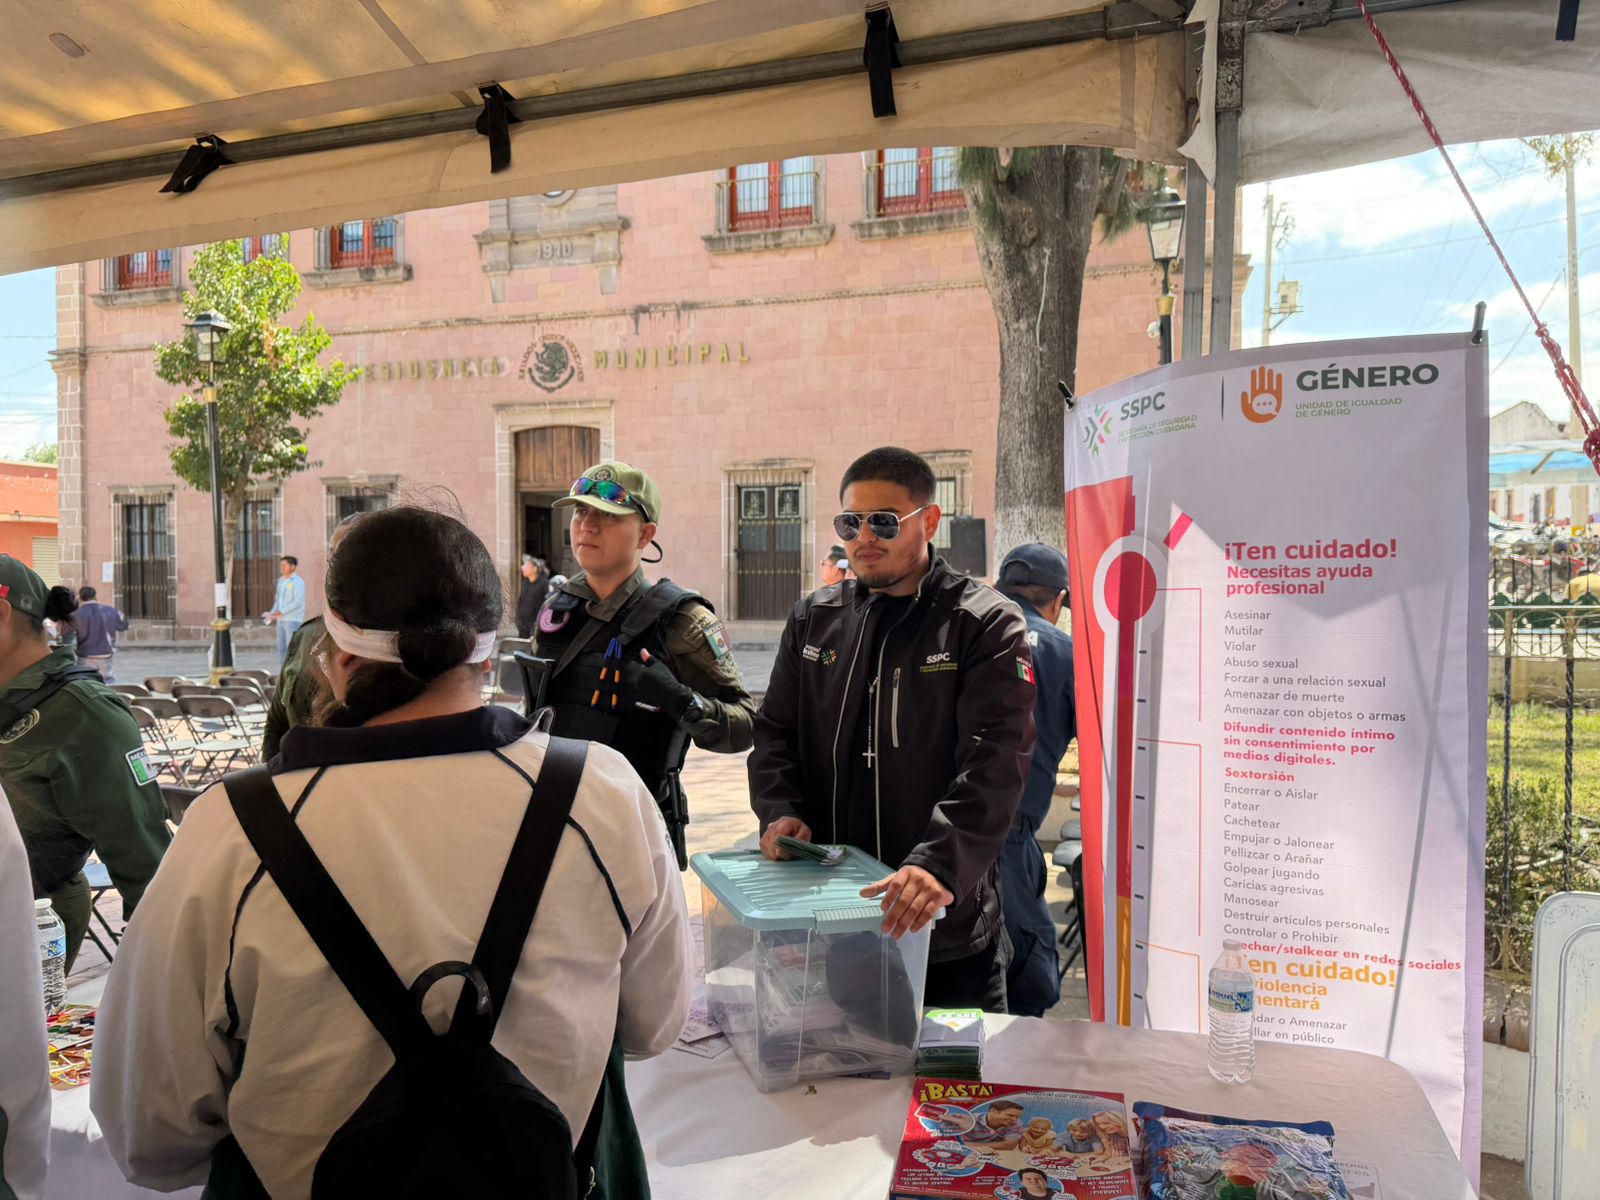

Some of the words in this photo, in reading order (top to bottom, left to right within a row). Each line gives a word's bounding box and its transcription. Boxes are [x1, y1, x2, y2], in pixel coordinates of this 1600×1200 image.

[593, 341, 751, 370] MUNICIPAL
[1296, 363, 1440, 392] GÉNERO
[1120, 391, 1166, 421] SSPC
[1295, 401, 1333, 410] UNIDAD
[1335, 400, 1349, 408] DE
[1351, 397, 1402, 407] IGUALDAD
[1295, 410, 1309, 418] DE
[1310, 408, 1351, 418] GÉNERO
[1225, 542, 1277, 561] ¡Ten
[1284, 538, 1397, 560] cuidado!
[1227, 565, 1311, 579] Necesitas
[1316, 564, 1373, 581] ayuda
[1226, 580, 1325, 598] profesional
[1224, 609, 1271, 620] Asesinar
[1224, 625, 1264, 636] Mutilar
[1224, 641, 1256, 652] Violar
[926, 652, 950, 664] SSPC
[1224, 657, 1259, 668] Abuso
[1262, 658, 1299, 669] sexual
[1224, 672, 1260, 684] Forzar
[1262, 676, 1269, 685] a
[1272, 676, 1294, 686] una
[1297, 675, 1344, 687] relación
[1347, 677, 1386, 688] sexual
[1224, 688, 1279, 701] Amenazar
[1283, 690, 1298, 701] de
[1302, 692, 1345, 703] muerte
[1224, 704, 1279, 717] Amenazar
[1283, 709, 1304, 718] con
[1308, 707, 1353, 721] objetos
[1356, 711, 1364, 720] o
[1368, 711, 1406, 722] armas
[1223, 721, 1275, 735] Difundir
[1279, 725, 1346, 739] contenido
[1223, 735, 1241, 746] sin
[1244, 738, 1346, 753] consentimiento
[1350, 744, 1376, 756] por
[1223, 750, 1270, 762] medios
[1273, 752, 1336, 767] digitales.
[1224, 767, 1295, 783] Sextorsión
[1224, 783, 1271, 797] Encerrar
[1274, 789, 1282, 798] o
[1285, 788, 1319, 801] Aislar
[1224, 799, 1260, 812] Patear
[1223, 815, 1281, 830] Cachetear
[1224, 831, 1270, 846] Empujar
[1273, 837, 1281, 846] o
[1284, 836, 1335, 850] Jalonear
[1224, 846, 1270, 861] Pellizcar
[1273, 853, 1281, 862] o
[1284, 852, 1324, 865] Arañar
[1223, 862, 1269, 877] Golpear
[1272, 866, 1320, 881] jugando
[1223, 877, 1267, 892] Caricias
[1270, 883, 1325, 897] agresivas
[1223, 893, 1279, 908] Manosear
[1223, 908, 1269, 923] Destruir
[1272, 913, 1322, 928] artículos
[1325, 918, 1390, 935] personales
[1223, 924, 1277, 940] Controlar
[1280, 930, 1288, 940] o
[1292, 926, 1338, 944] Prohibir
[1240, 941, 1339, 958] echar/stalkear
[1343, 950, 1360, 959] en
[1364, 952, 1404, 967] redes
[1408, 959, 1462, 971] sociales
[1285, 959, 1397, 989] cuidado!
[1278, 1017, 1286, 1026] o
[1289, 1016, 1348, 1031] Amenazar
[1275, 1031, 1289, 1040] en
[1292, 1031, 1335, 1045] público
[920, 1083, 993, 1102] ¡BASTA!
